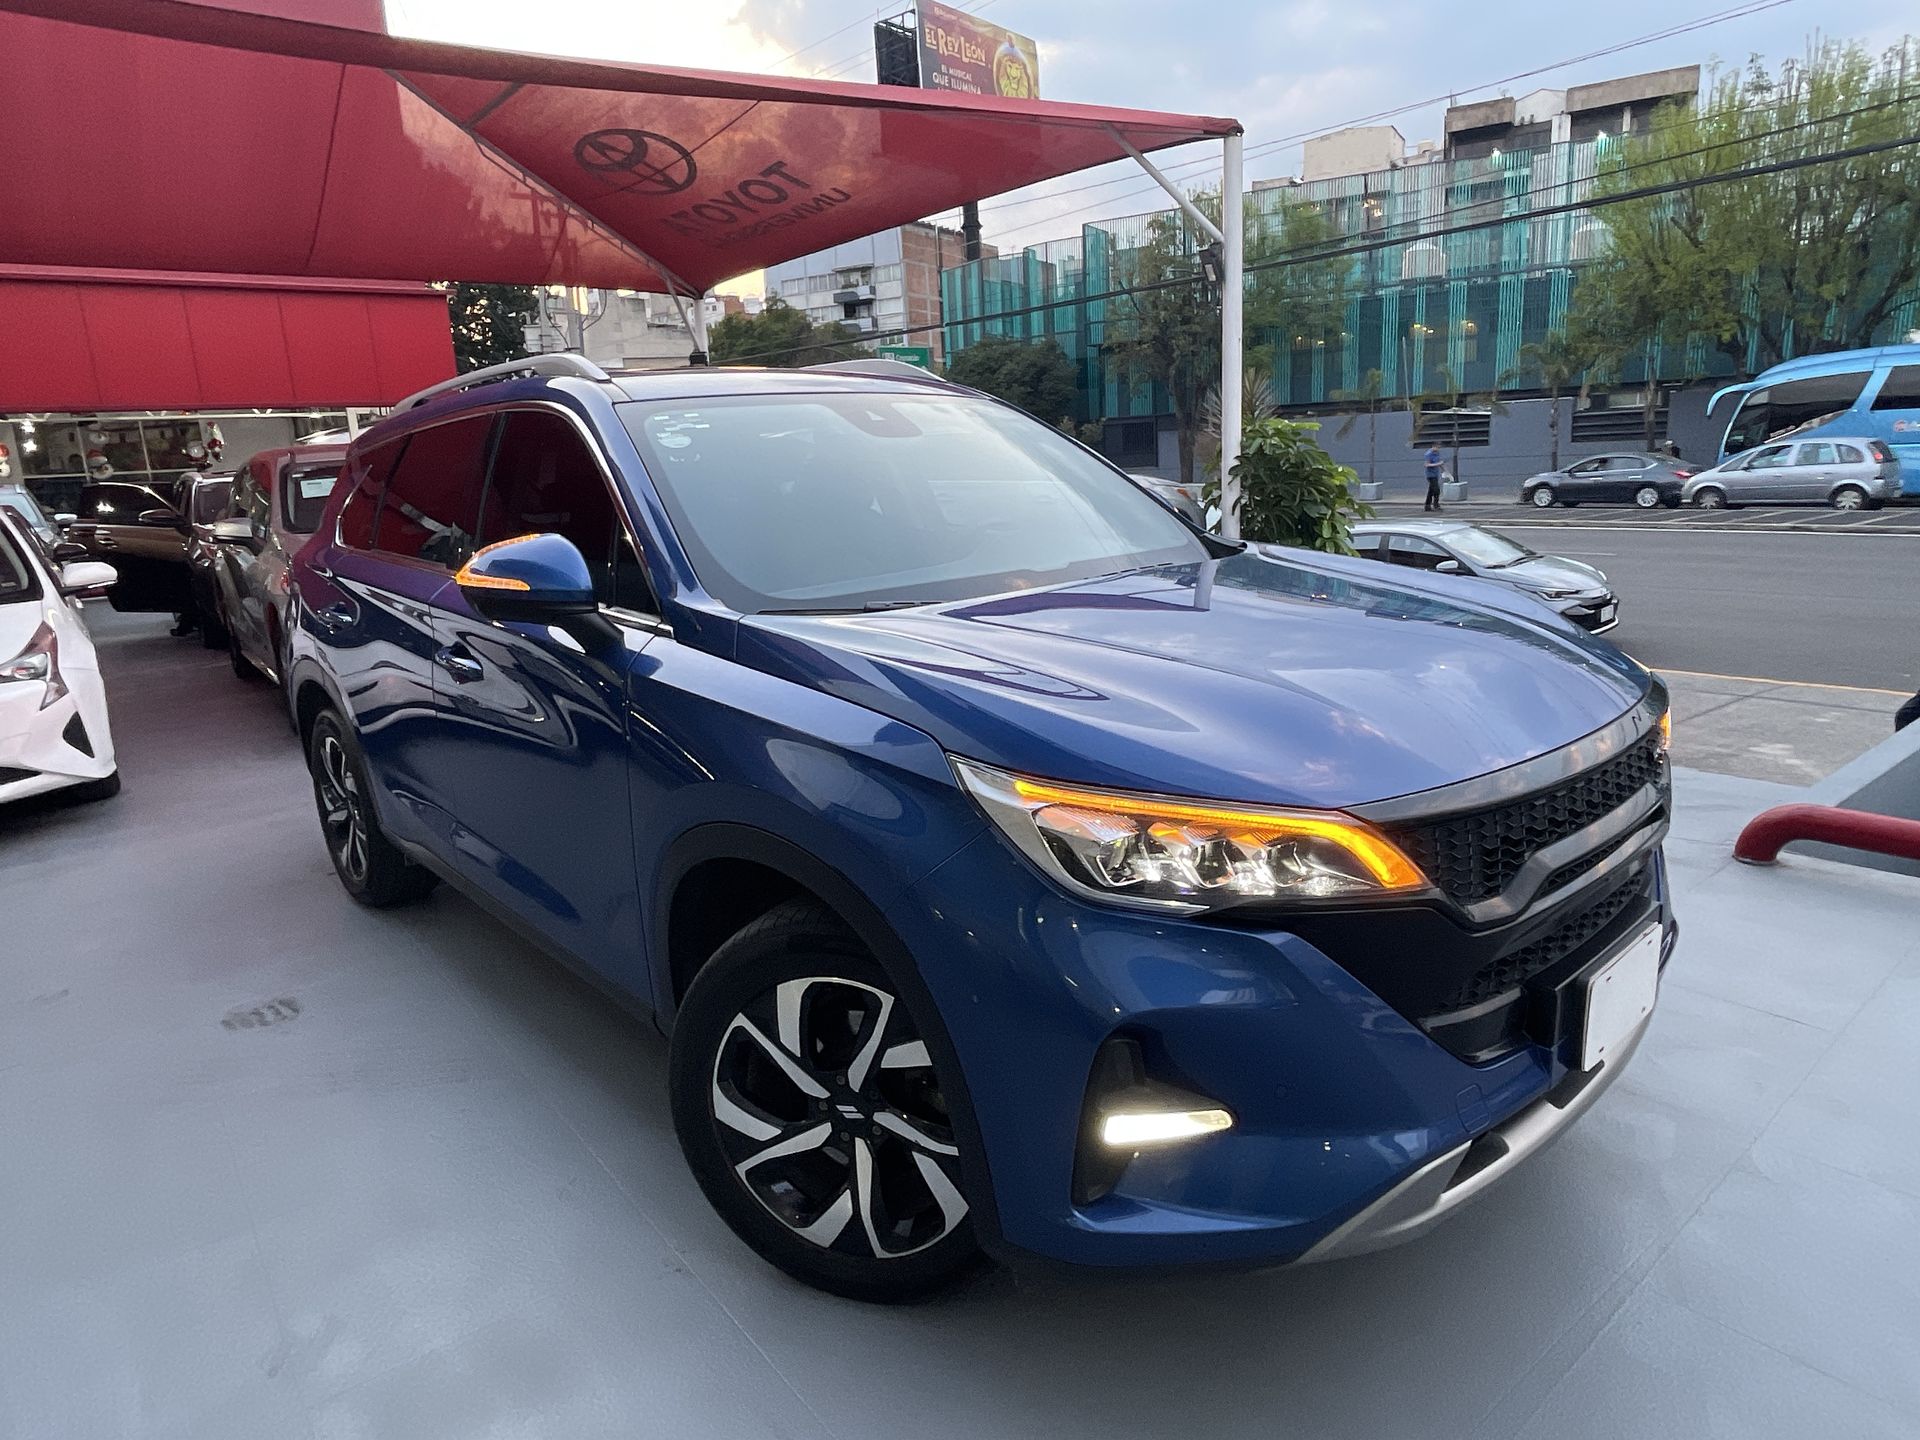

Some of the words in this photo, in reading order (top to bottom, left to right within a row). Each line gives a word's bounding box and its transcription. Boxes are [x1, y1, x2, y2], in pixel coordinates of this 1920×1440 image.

[924, 27, 937, 46] EL
[937, 27, 960, 56] REY
[932, 72, 949, 87] QUE
[951, 78, 982, 95] ILUMINA
